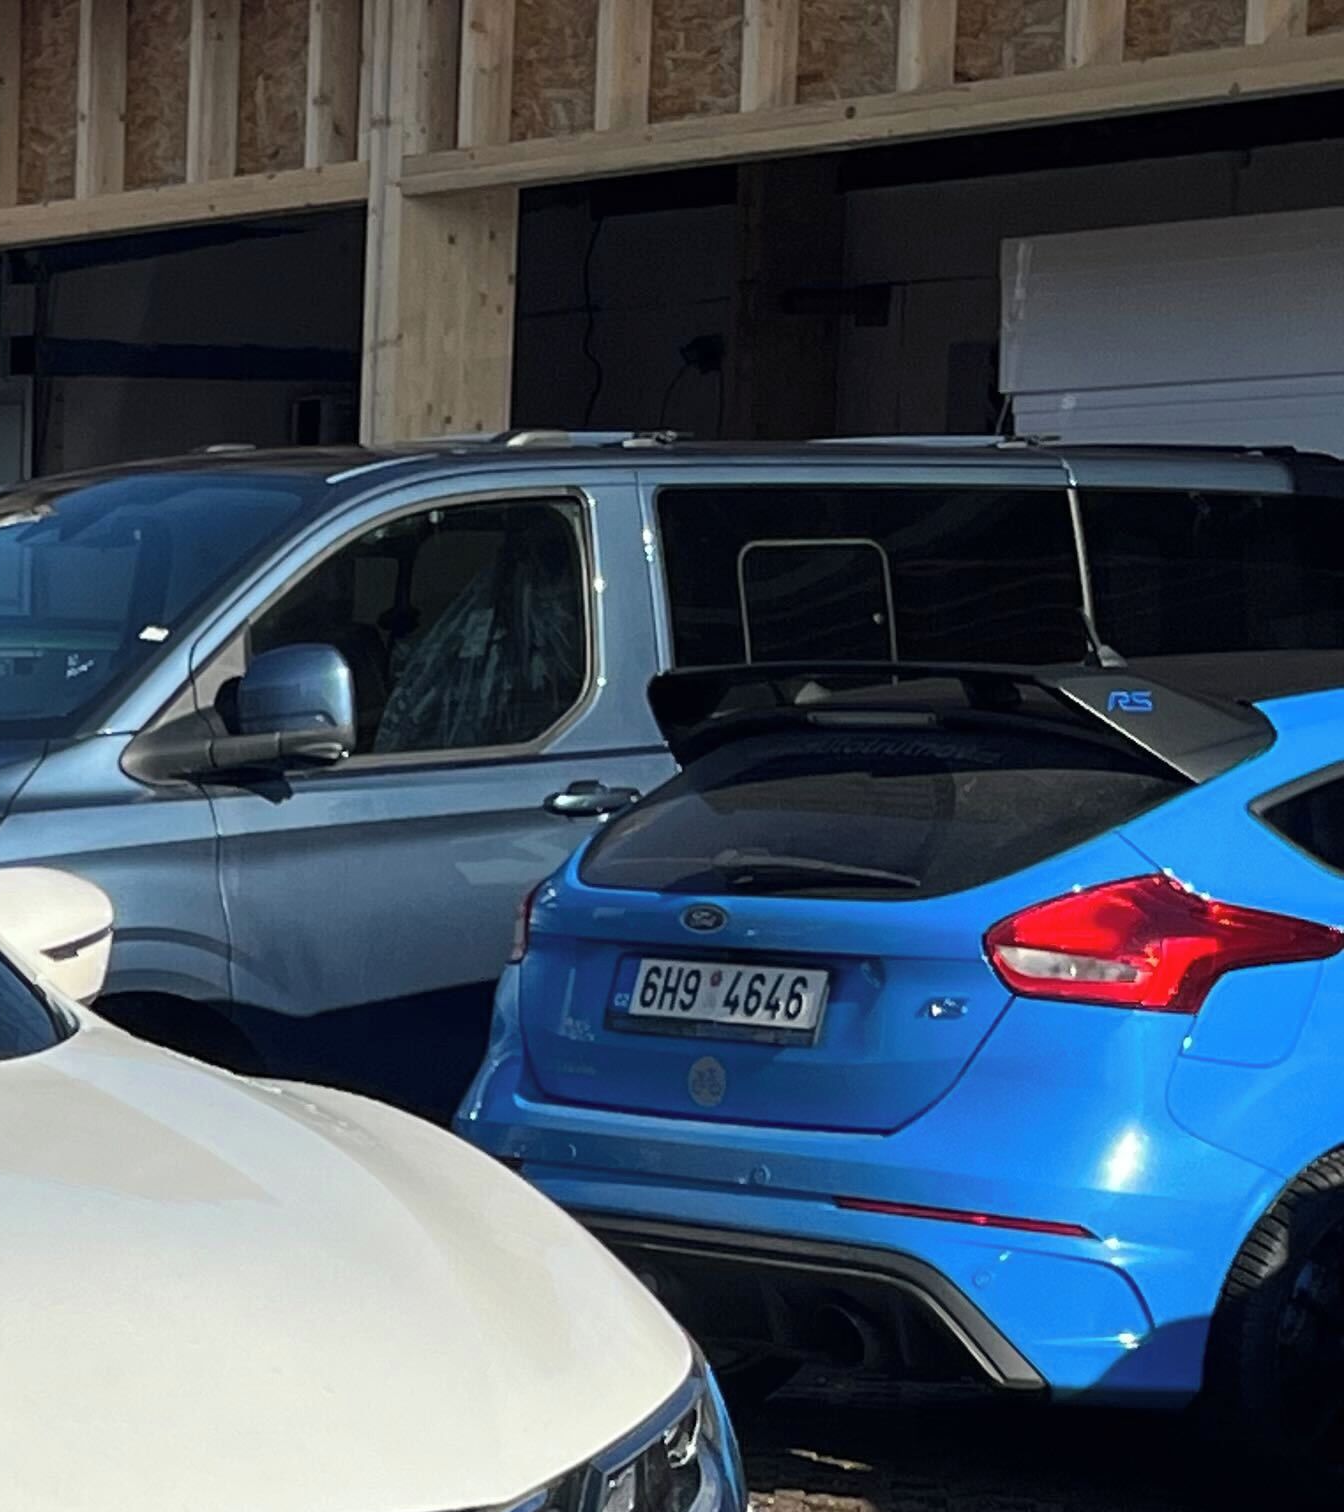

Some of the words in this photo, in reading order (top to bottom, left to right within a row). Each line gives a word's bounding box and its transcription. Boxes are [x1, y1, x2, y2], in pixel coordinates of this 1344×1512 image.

[1107, 690, 1153, 712] RS
[639, 964, 703, 1012] 6H9
[723, 970, 809, 1019] 4646
